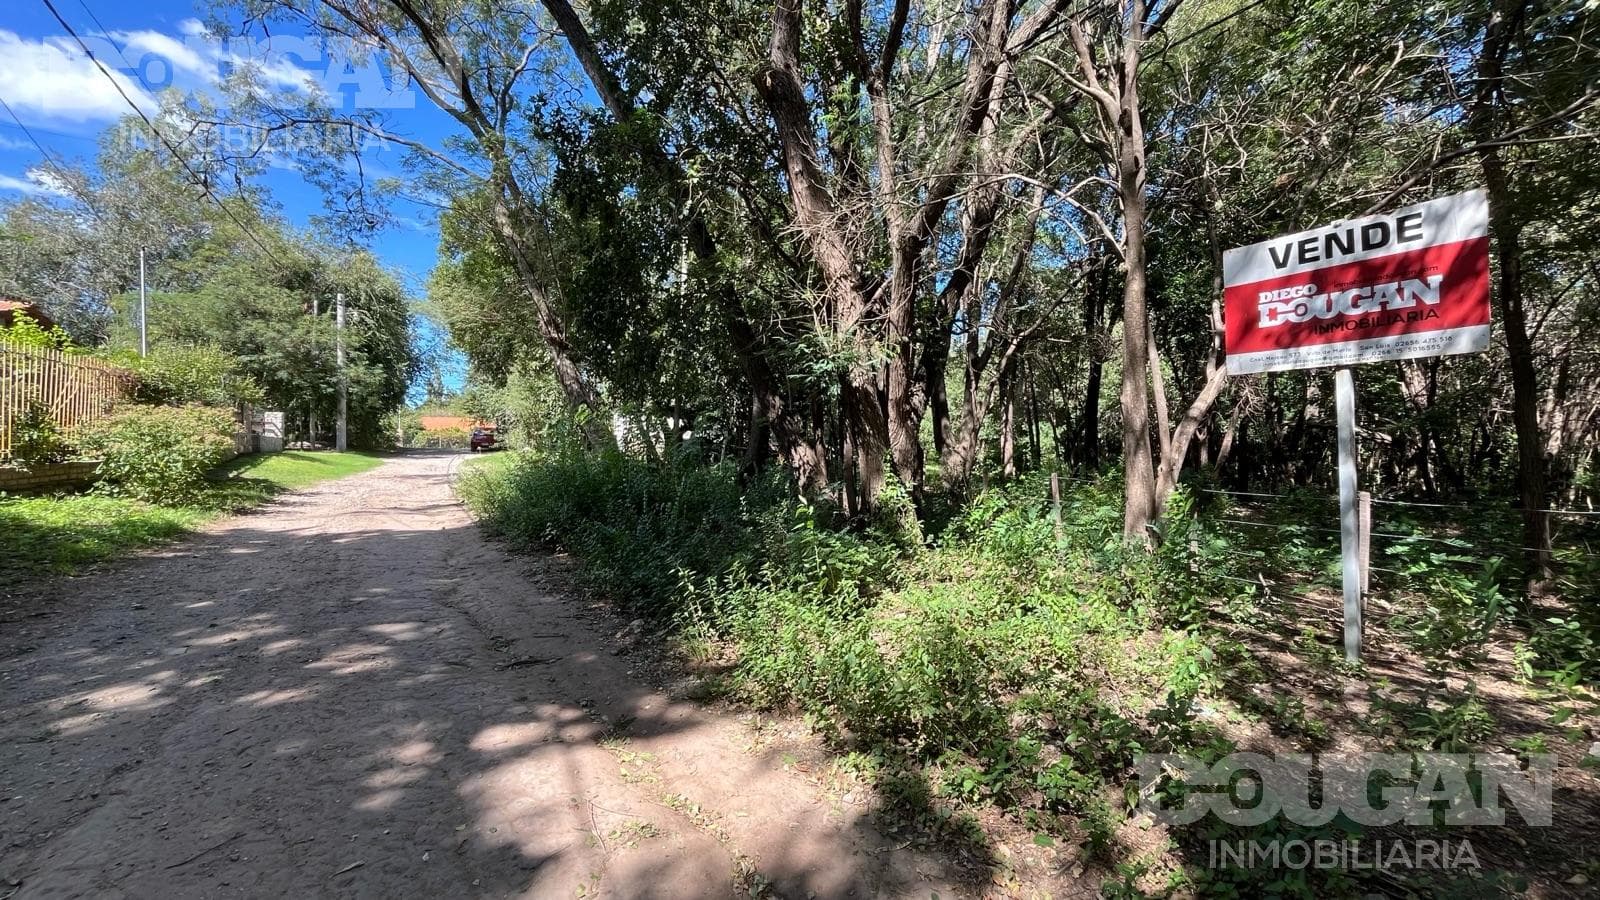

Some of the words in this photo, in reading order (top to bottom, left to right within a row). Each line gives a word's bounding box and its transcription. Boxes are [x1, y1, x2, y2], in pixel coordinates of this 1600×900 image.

[1268, 212, 1424, 270] VENDE
[1258, 283, 1318, 304] DIEGO
[1258, 274, 1444, 329] DOUGAN
[1314, 308, 1439, 335] INMOBILIARIA
